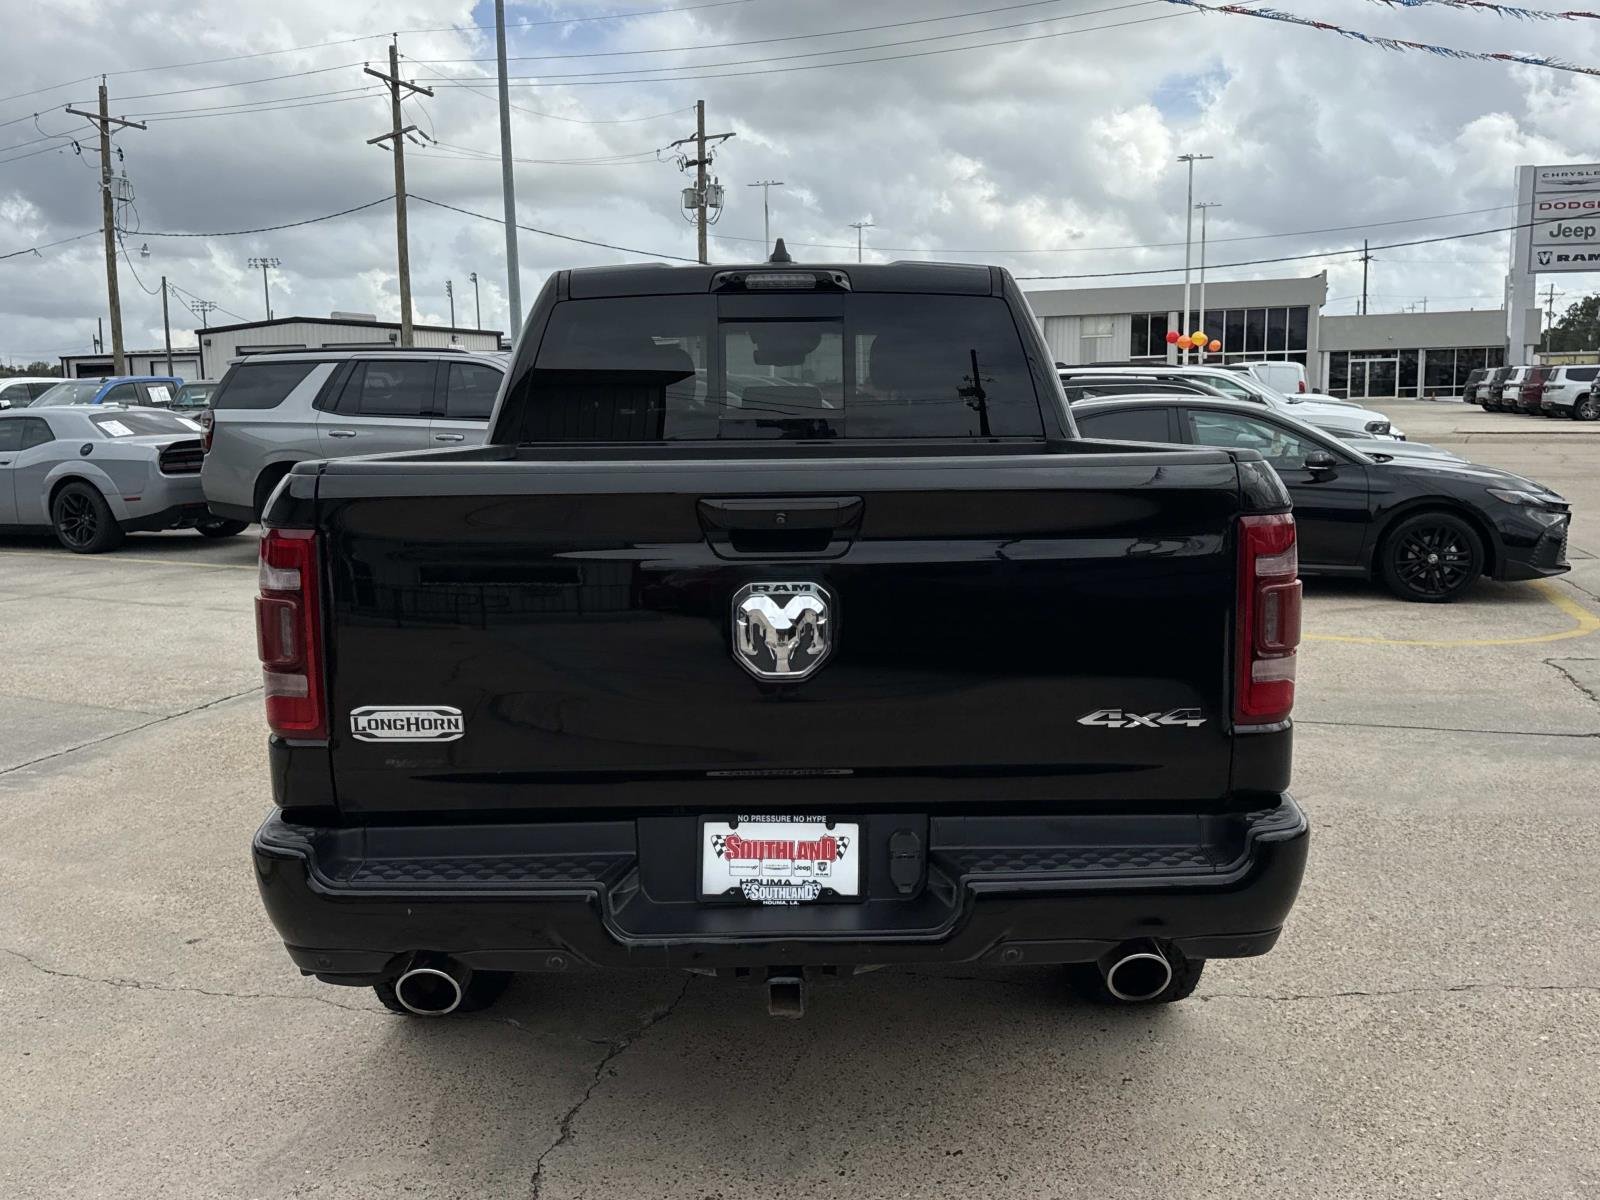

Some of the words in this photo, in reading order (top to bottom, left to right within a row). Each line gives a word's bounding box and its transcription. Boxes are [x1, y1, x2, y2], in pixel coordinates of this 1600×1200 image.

[1539, 200, 1600, 210] DODG
[1549, 223, 1596, 240] Jeep
[1557, 254, 1600, 262] RAM
[751, 583, 812, 593] RAM
[353, 716, 460, 732] LONGHORN
[751, 815, 791, 823] PRESSURE
[725, 836, 838, 861] SOUTHLAND
[750, 884, 813, 900] SOUTHLAND
